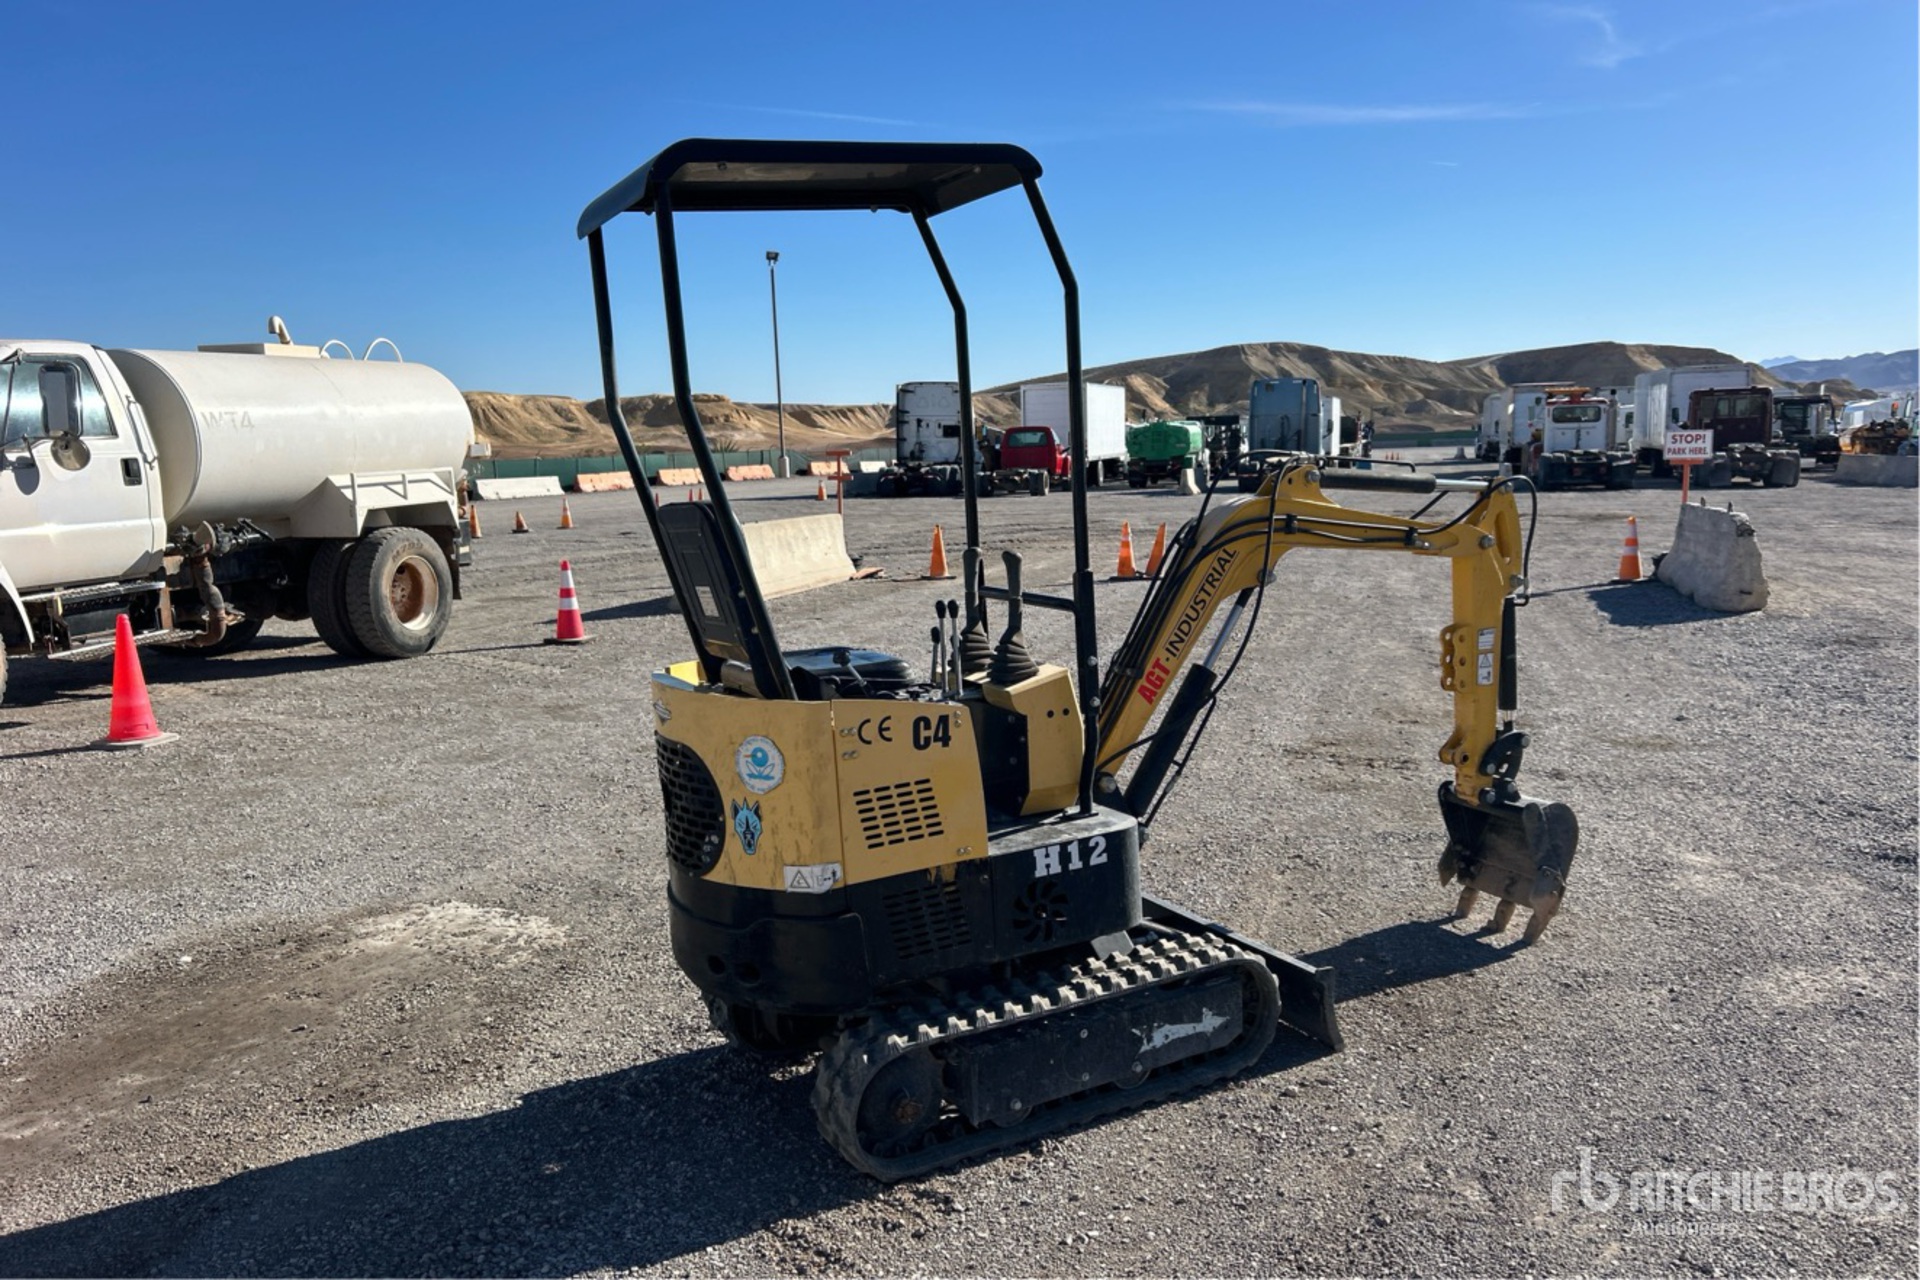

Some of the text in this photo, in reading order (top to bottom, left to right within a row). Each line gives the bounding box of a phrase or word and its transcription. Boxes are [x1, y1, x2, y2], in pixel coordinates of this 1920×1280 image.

[200, 411, 255, 431] WT4
[1667, 447, 1687, 455] PARK
[1671, 433, 1706, 444] STOP!
[858, 715, 893, 745] CE
[912, 714, 952, 751] C4
[1033, 836, 1108, 878] H12
